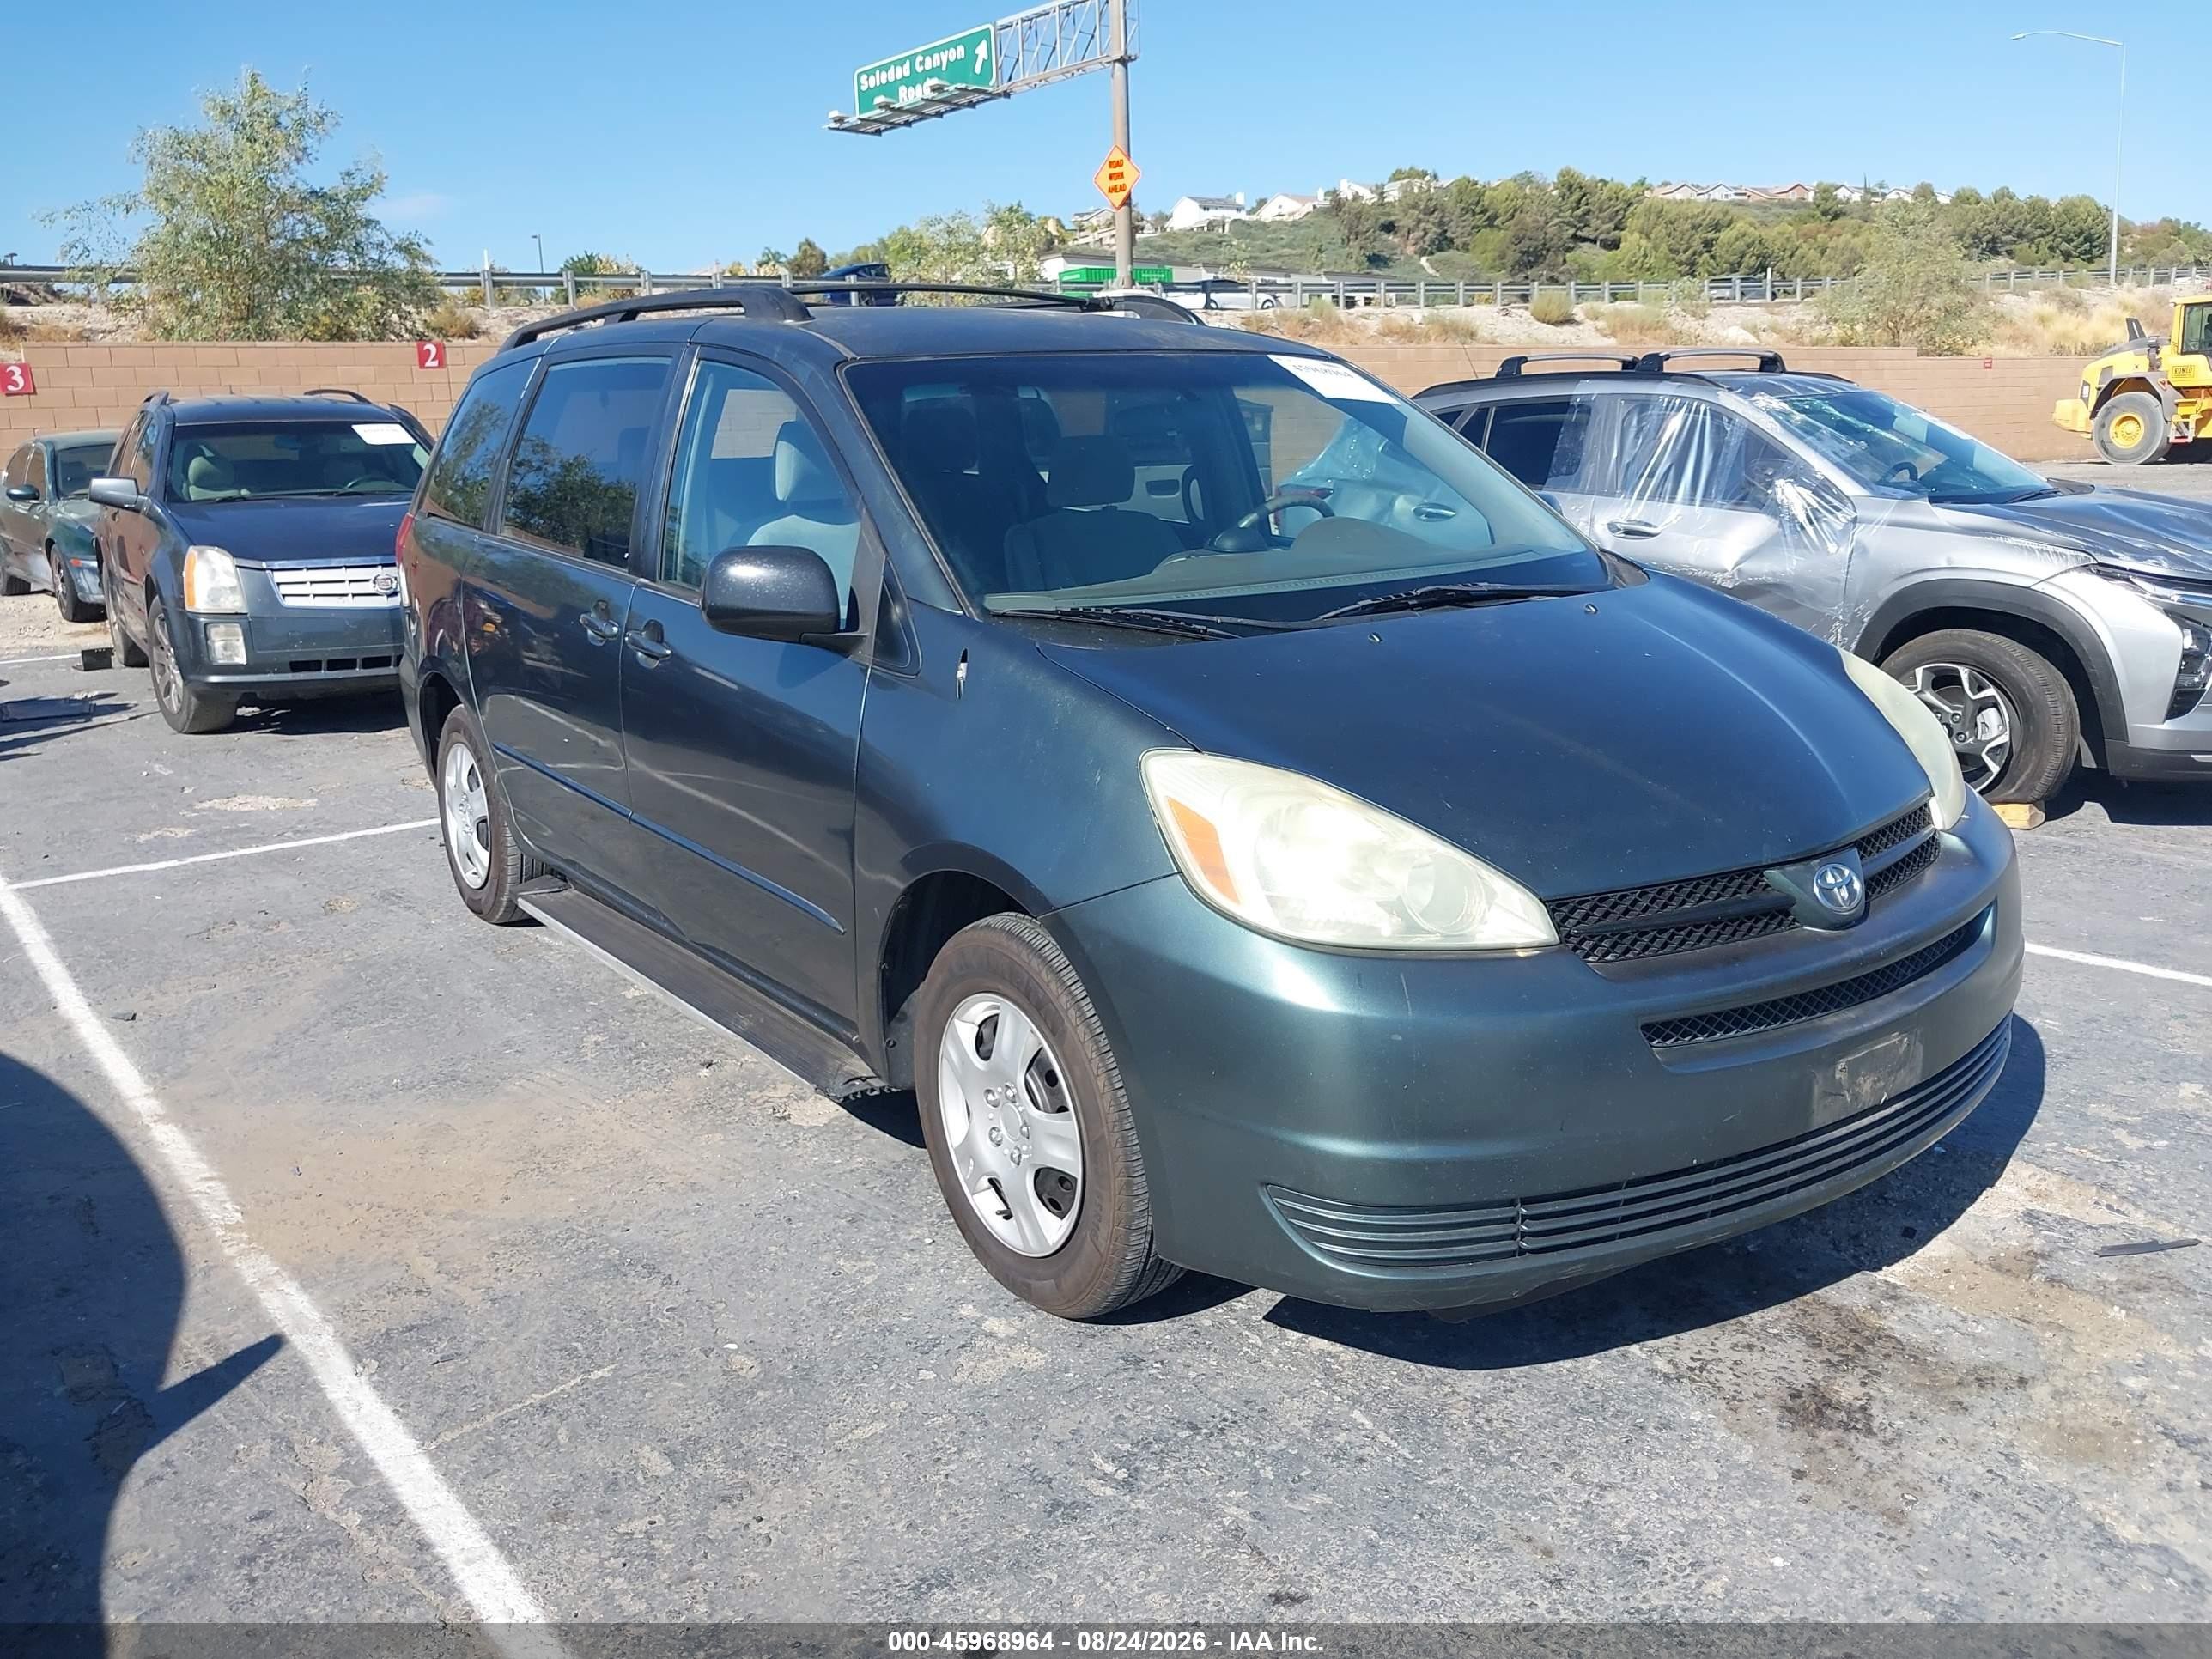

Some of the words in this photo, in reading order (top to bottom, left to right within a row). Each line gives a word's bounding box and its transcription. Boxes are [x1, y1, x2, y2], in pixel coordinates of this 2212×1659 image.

[860, 59, 911, 92] Soledad
[915, 44, 965, 74] Canyon
[1109, 159, 1124, 169] ROAD
[1109, 171, 1125, 181] WORK
[1108, 183, 1127, 193] AHEAD
[423, 343, 439, 367] 2
[5, 365, 25, 391] 3
